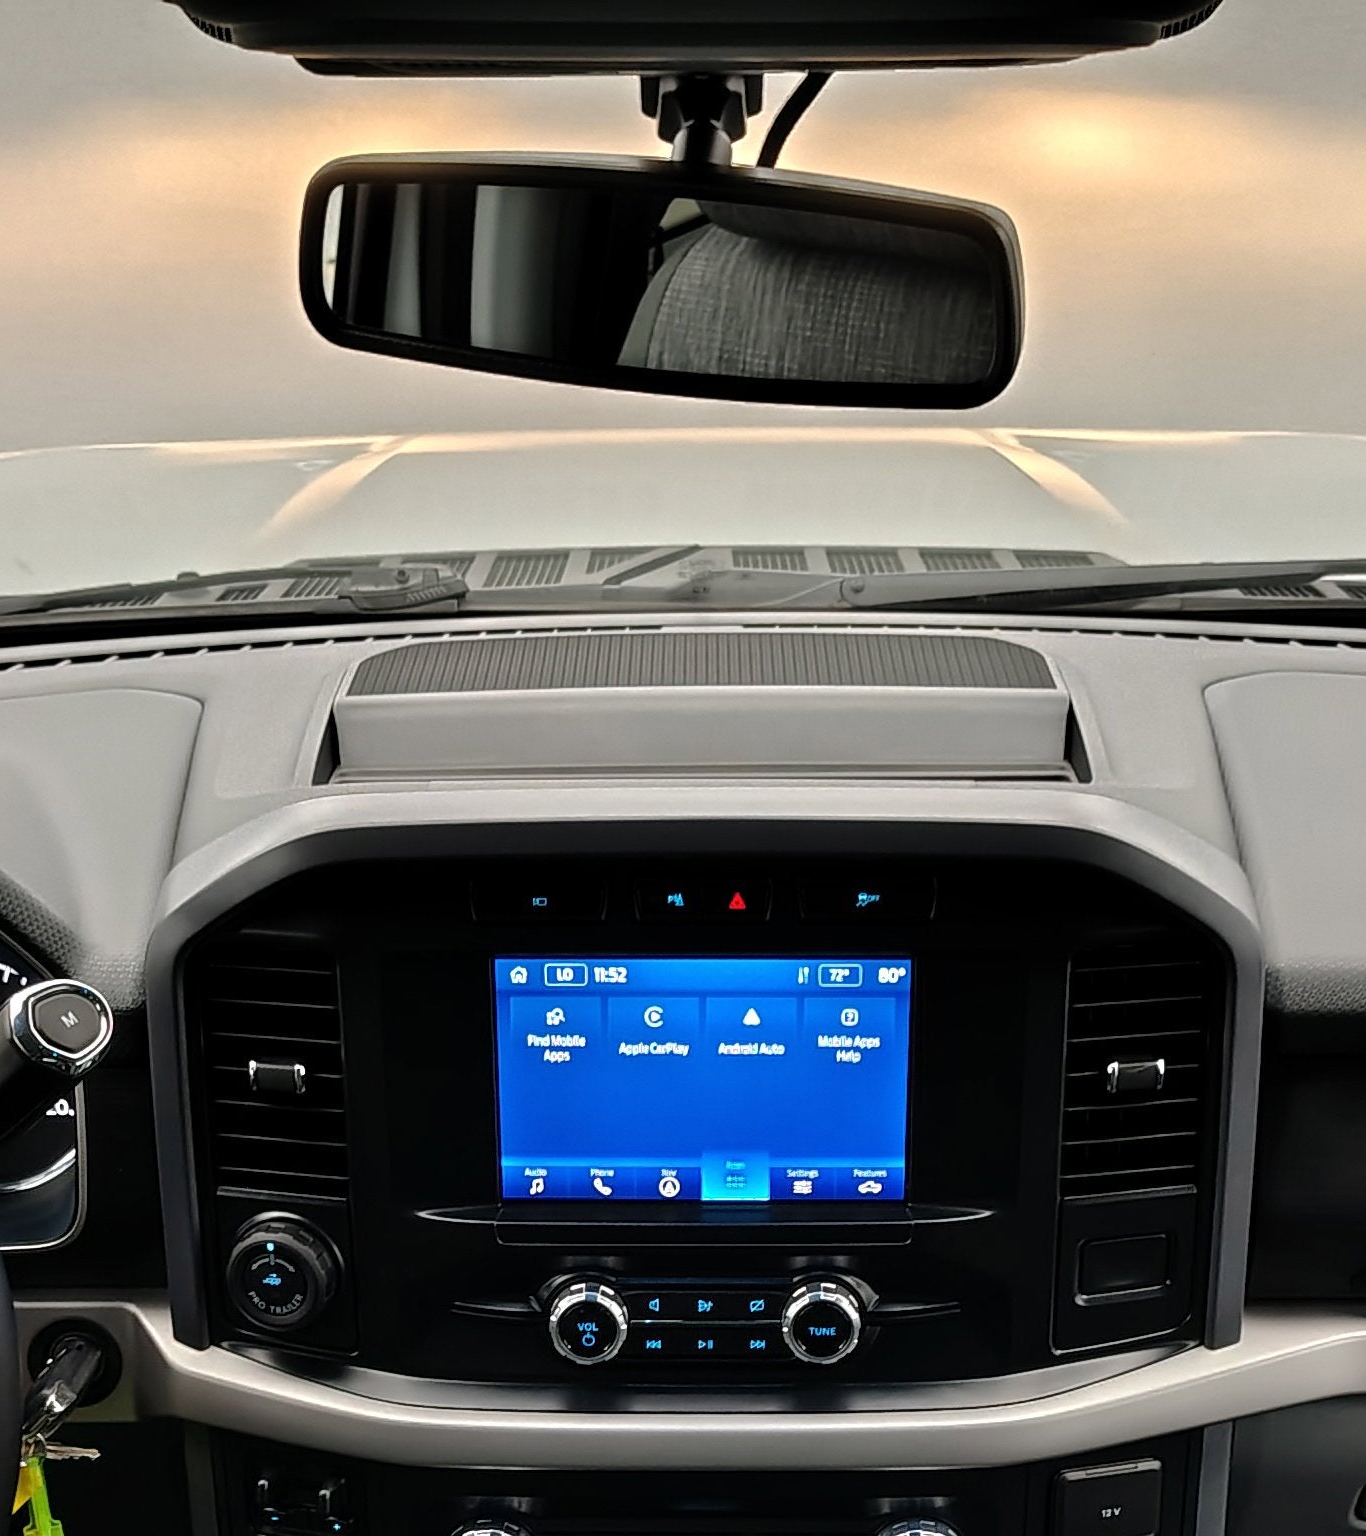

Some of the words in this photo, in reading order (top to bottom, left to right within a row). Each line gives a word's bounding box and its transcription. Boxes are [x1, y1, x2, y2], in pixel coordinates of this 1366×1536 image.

[594, 966, 628, 984] 11:52
[60, 1010, 80, 1028] M
[527, 1034, 550, 1047] Find
[550, 1034, 586, 1047] Mobile
[817, 1034, 853, 1047] Mobile
[853, 1034, 880, 1049] Apps
[618, 1042, 649, 1056] Apple
[649, 1042, 690, 1056] CarPlay
[718, 1042, 759, 1055] Android
[759, 1042, 786, 1055] Auto
[543, 1049, 571, 1063] Apps
[248, 1290, 266, 1310] PRO
[269, 1293, 304, 1314] TRAILER
[577, 1321, 599, 1333] VOL
[808, 1326, 837, 1337] TUNE
[1113, 1507, 1122, 1516] V
